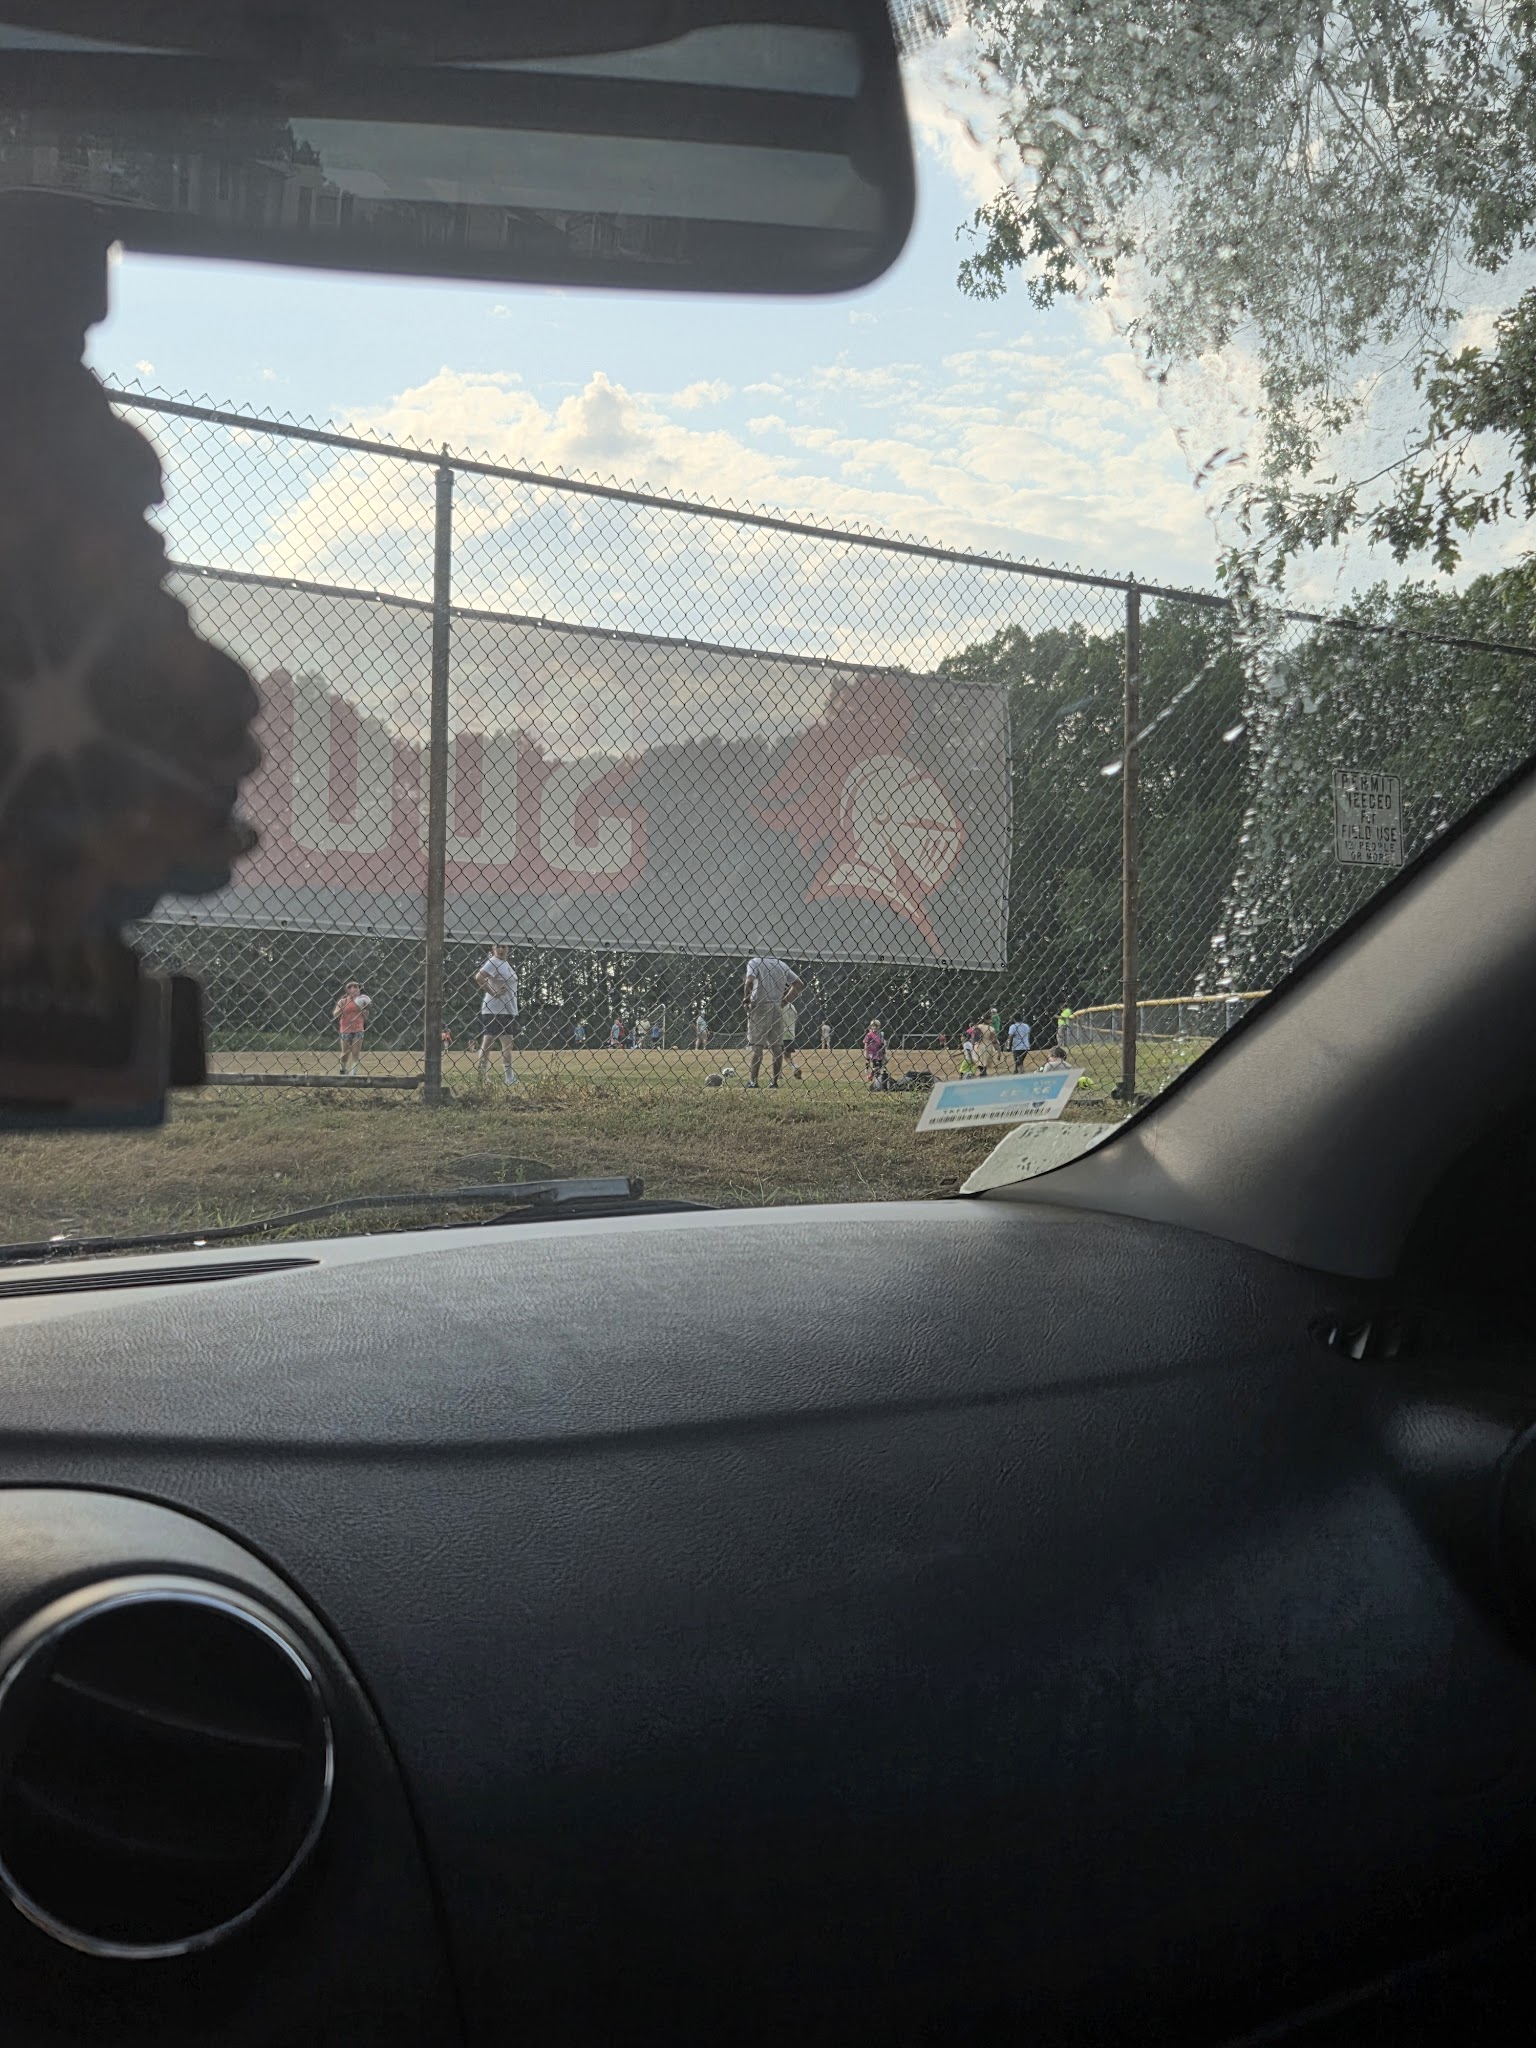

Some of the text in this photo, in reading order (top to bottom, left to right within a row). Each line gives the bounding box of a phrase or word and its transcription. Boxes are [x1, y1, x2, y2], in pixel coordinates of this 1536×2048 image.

[1341, 773, 1393, 793] PERMIT
[1341, 824, 1397, 842] FIELD USE
[1359, 841, 1395, 853] PEOPLE
